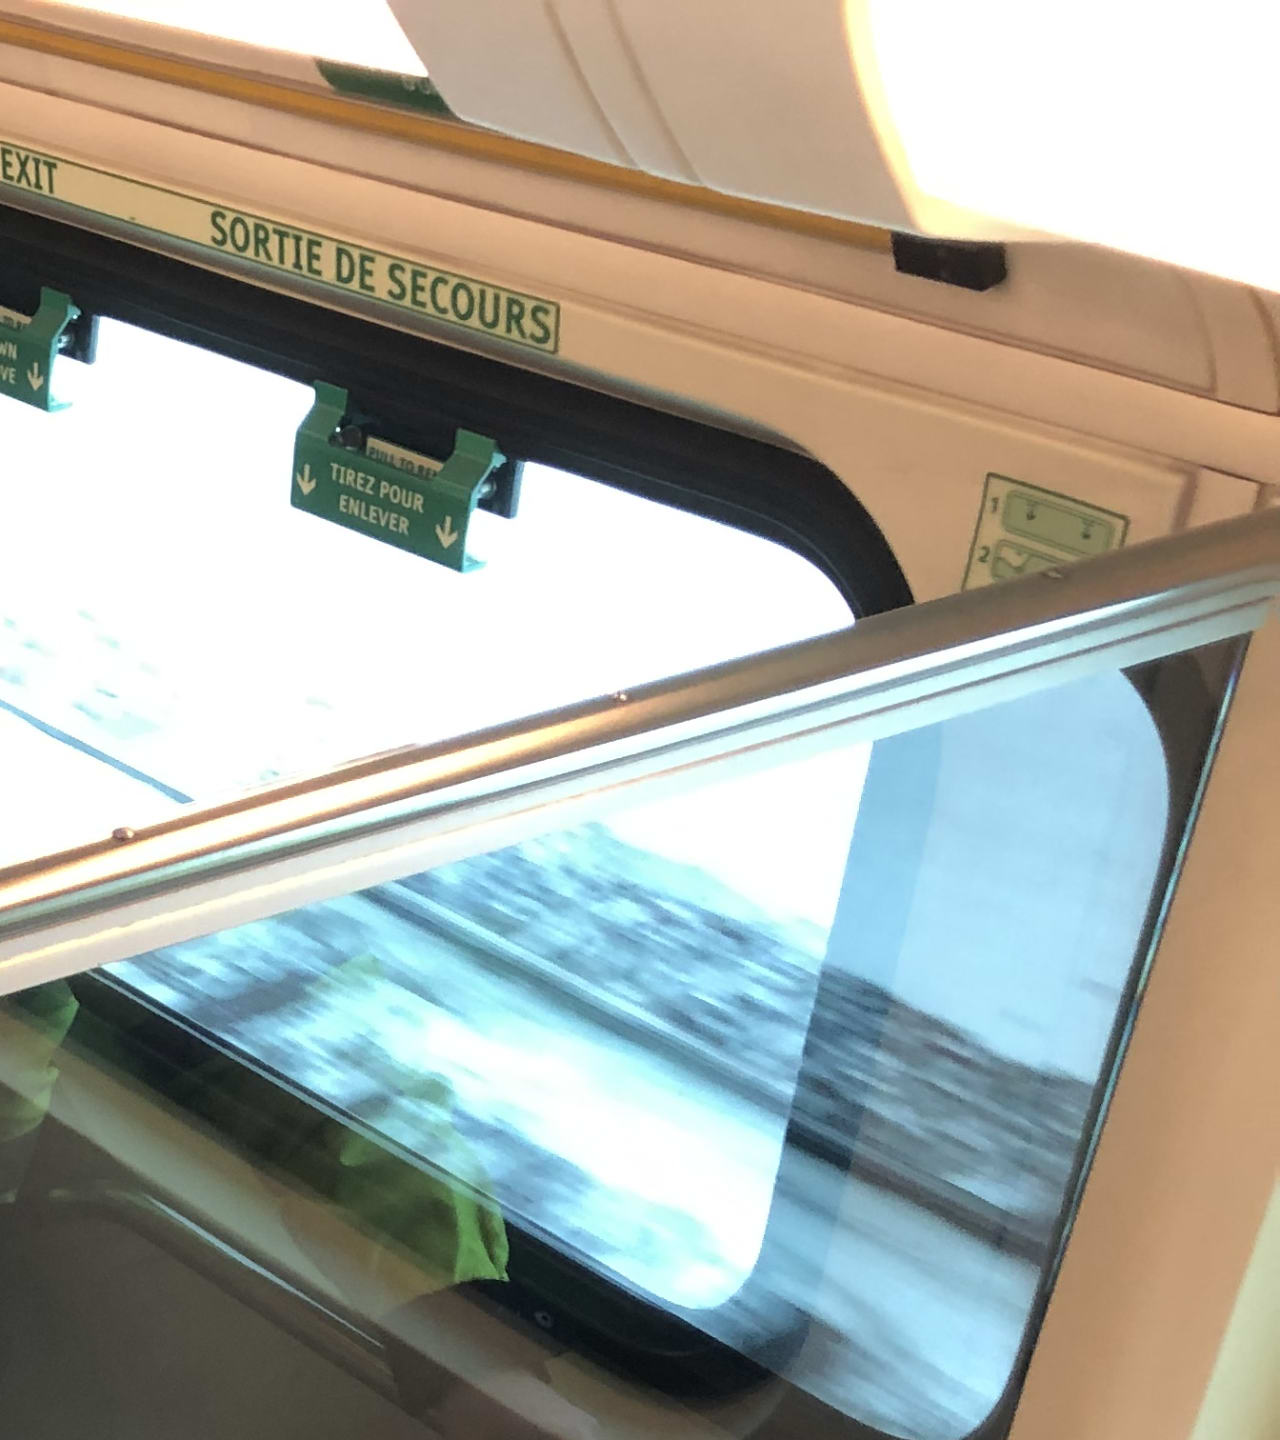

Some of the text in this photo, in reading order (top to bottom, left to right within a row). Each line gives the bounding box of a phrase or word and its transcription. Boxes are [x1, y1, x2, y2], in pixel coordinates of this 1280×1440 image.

[0, 147, 57, 194] EXIT
[210, 210, 551, 345] SORTIE DE SECOURS
[330, 462, 424, 513] TIREZ POUR
[339, 494, 410, 535] ENLEVER
